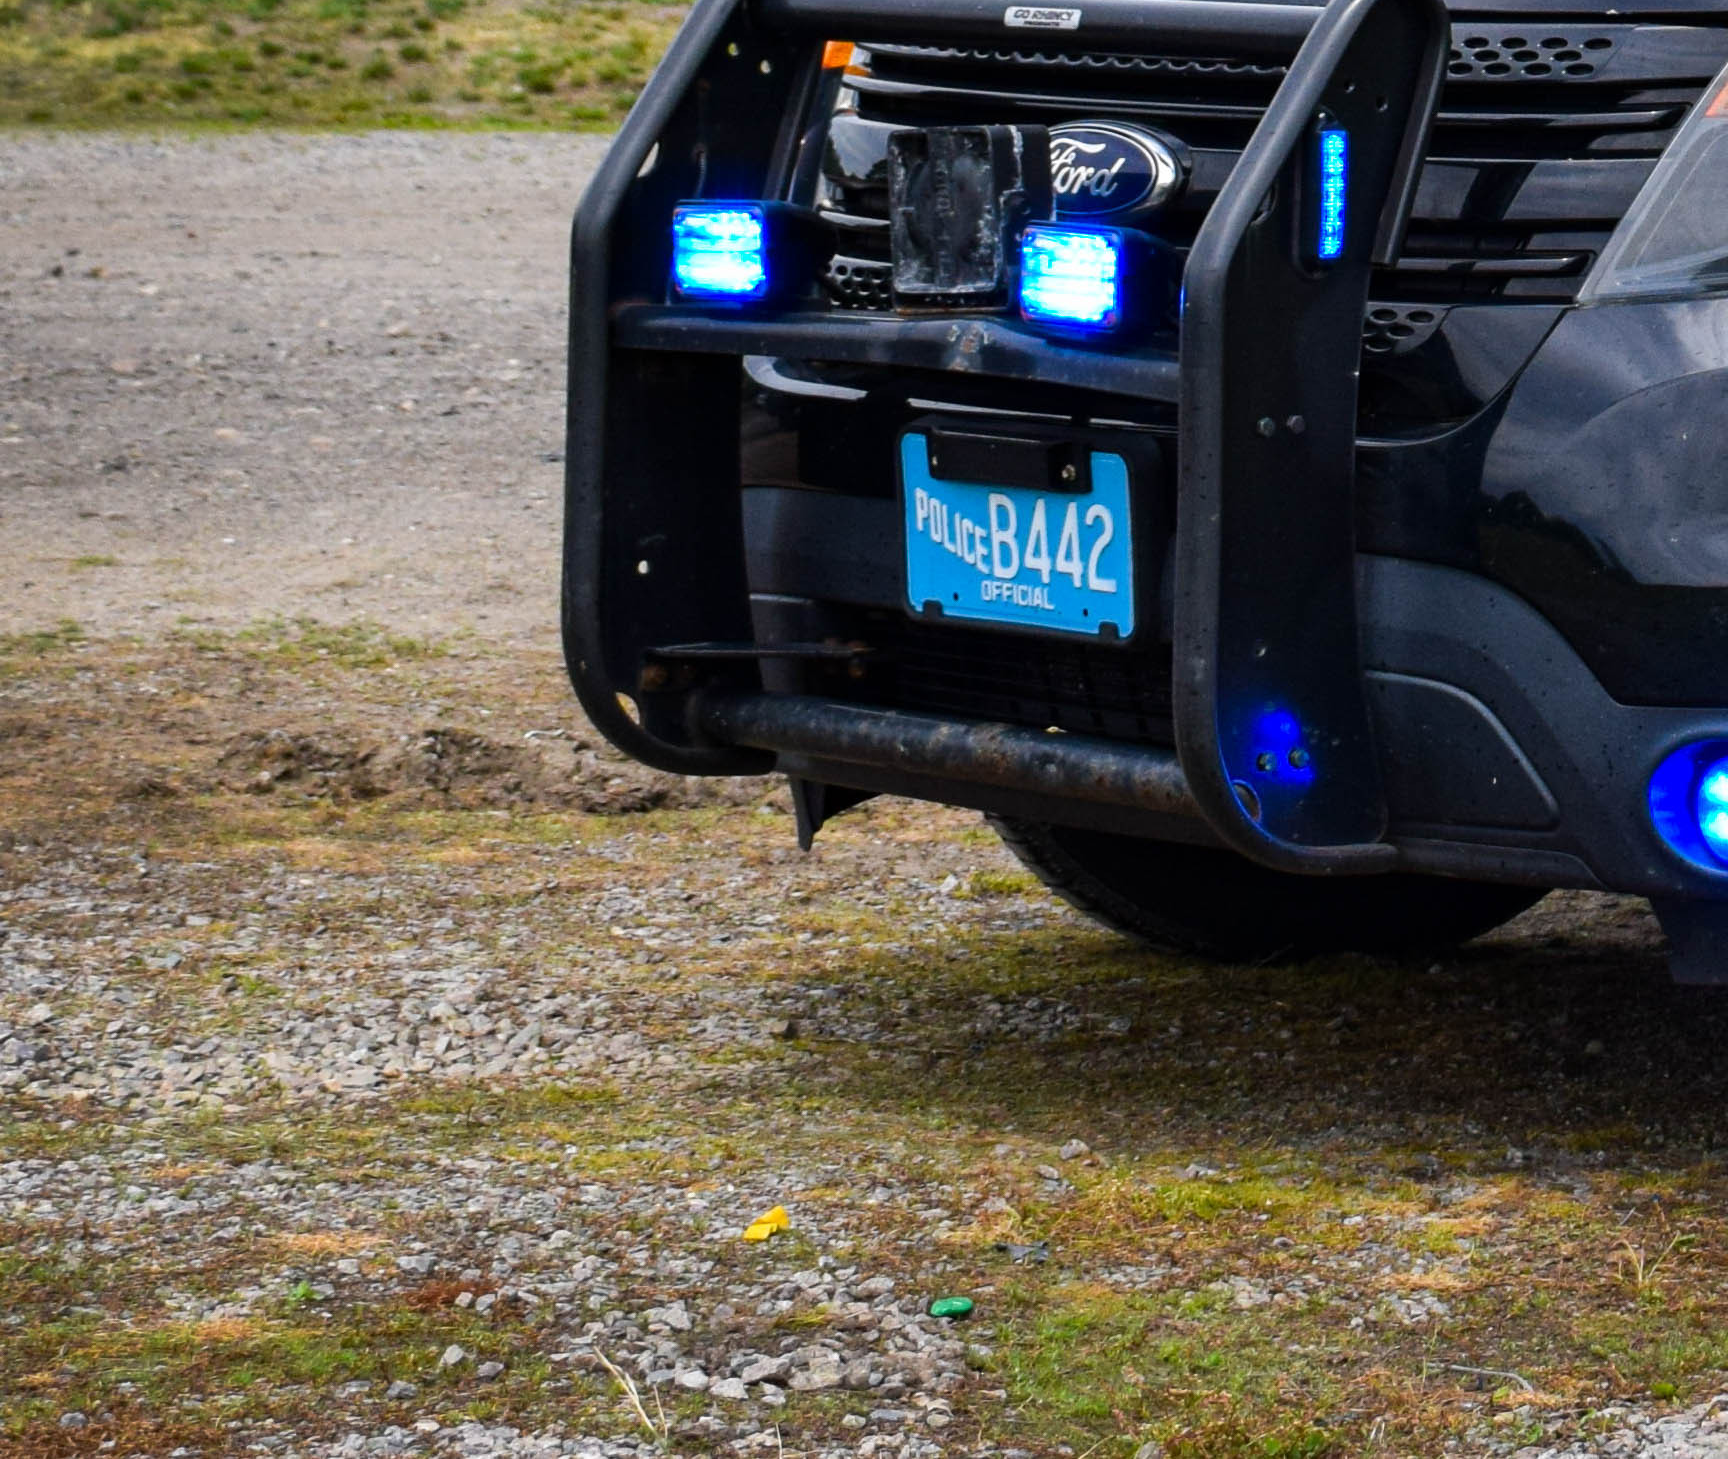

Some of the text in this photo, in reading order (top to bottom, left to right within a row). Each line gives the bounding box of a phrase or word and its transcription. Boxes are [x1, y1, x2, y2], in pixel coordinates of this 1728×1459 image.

[1050, 137, 1126, 198] Ford
[914, 487, 1118, 593] POLICE B442
[981, 580, 1055, 610] OFFICIAL
